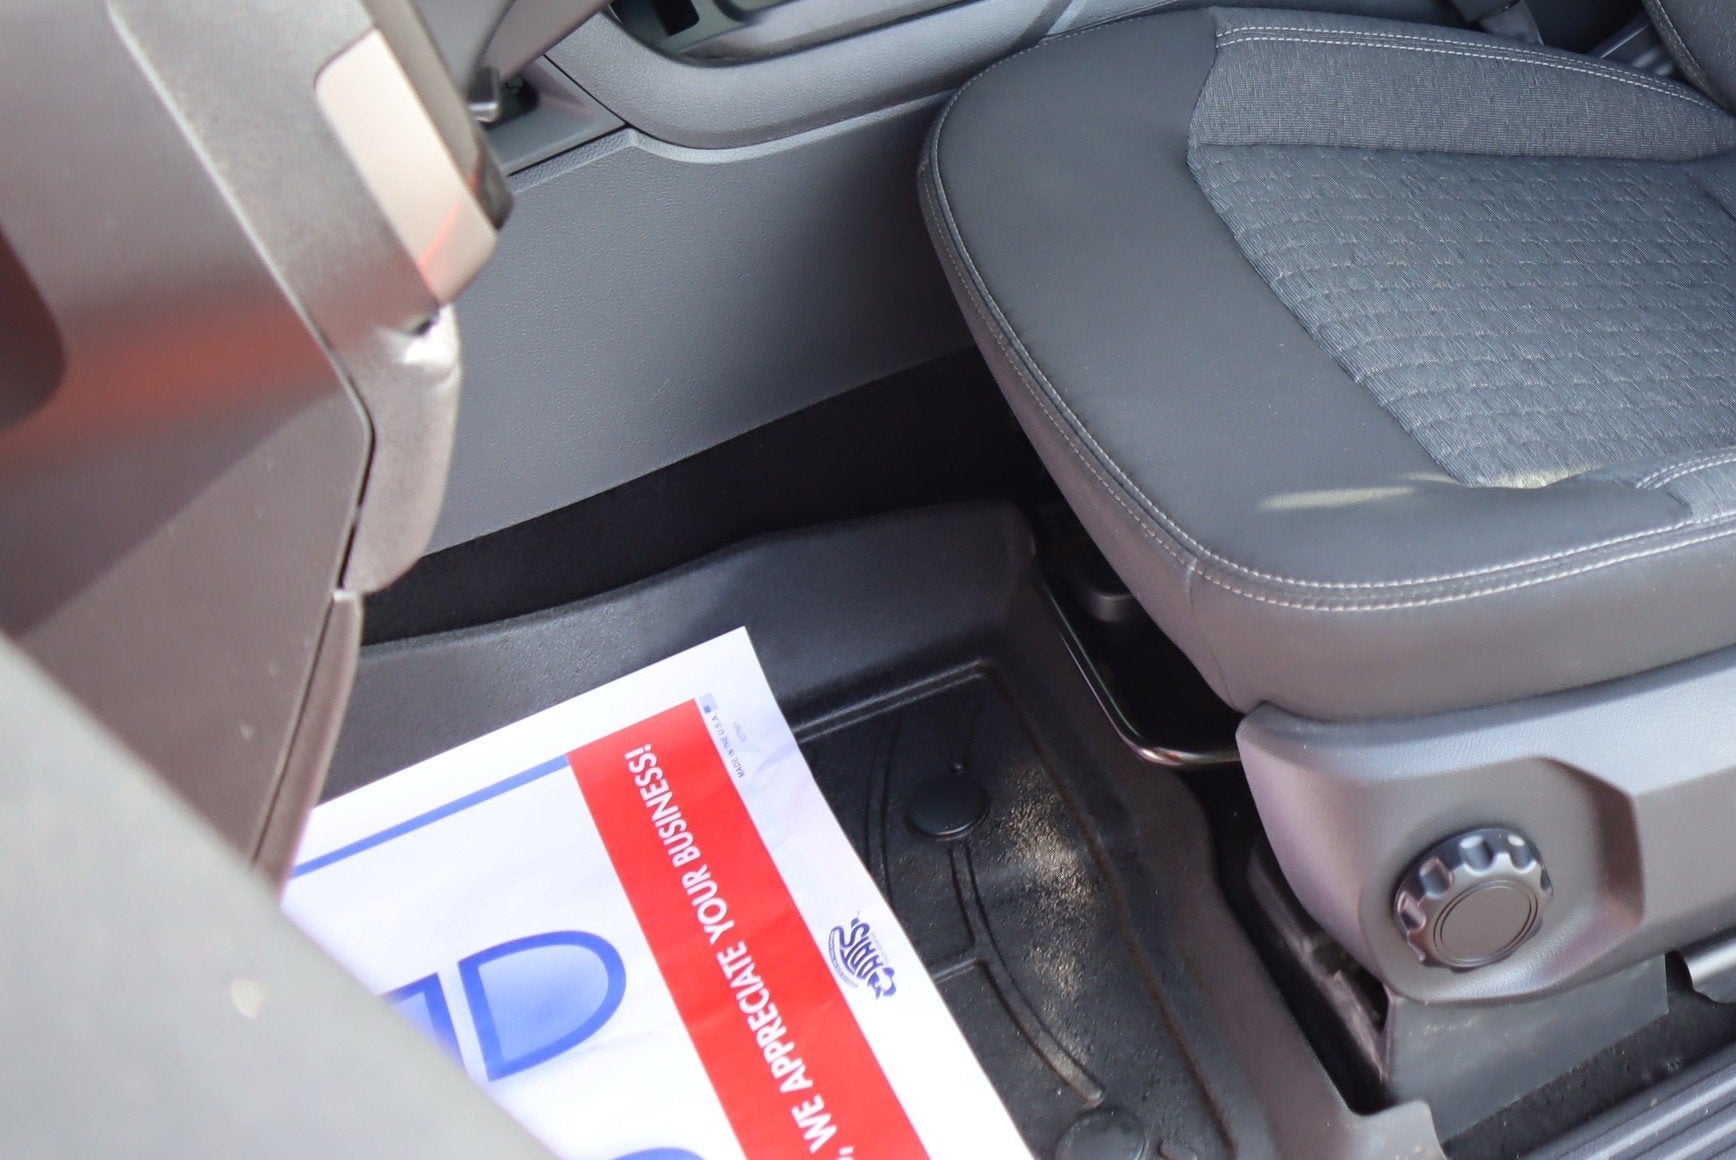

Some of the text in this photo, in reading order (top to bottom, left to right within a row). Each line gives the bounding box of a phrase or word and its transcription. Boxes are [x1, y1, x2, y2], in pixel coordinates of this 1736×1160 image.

[732, 757, 745, 778] MADE
[624, 743, 838, 1154] WE APPRECIATE YOUR BUSINESS!
